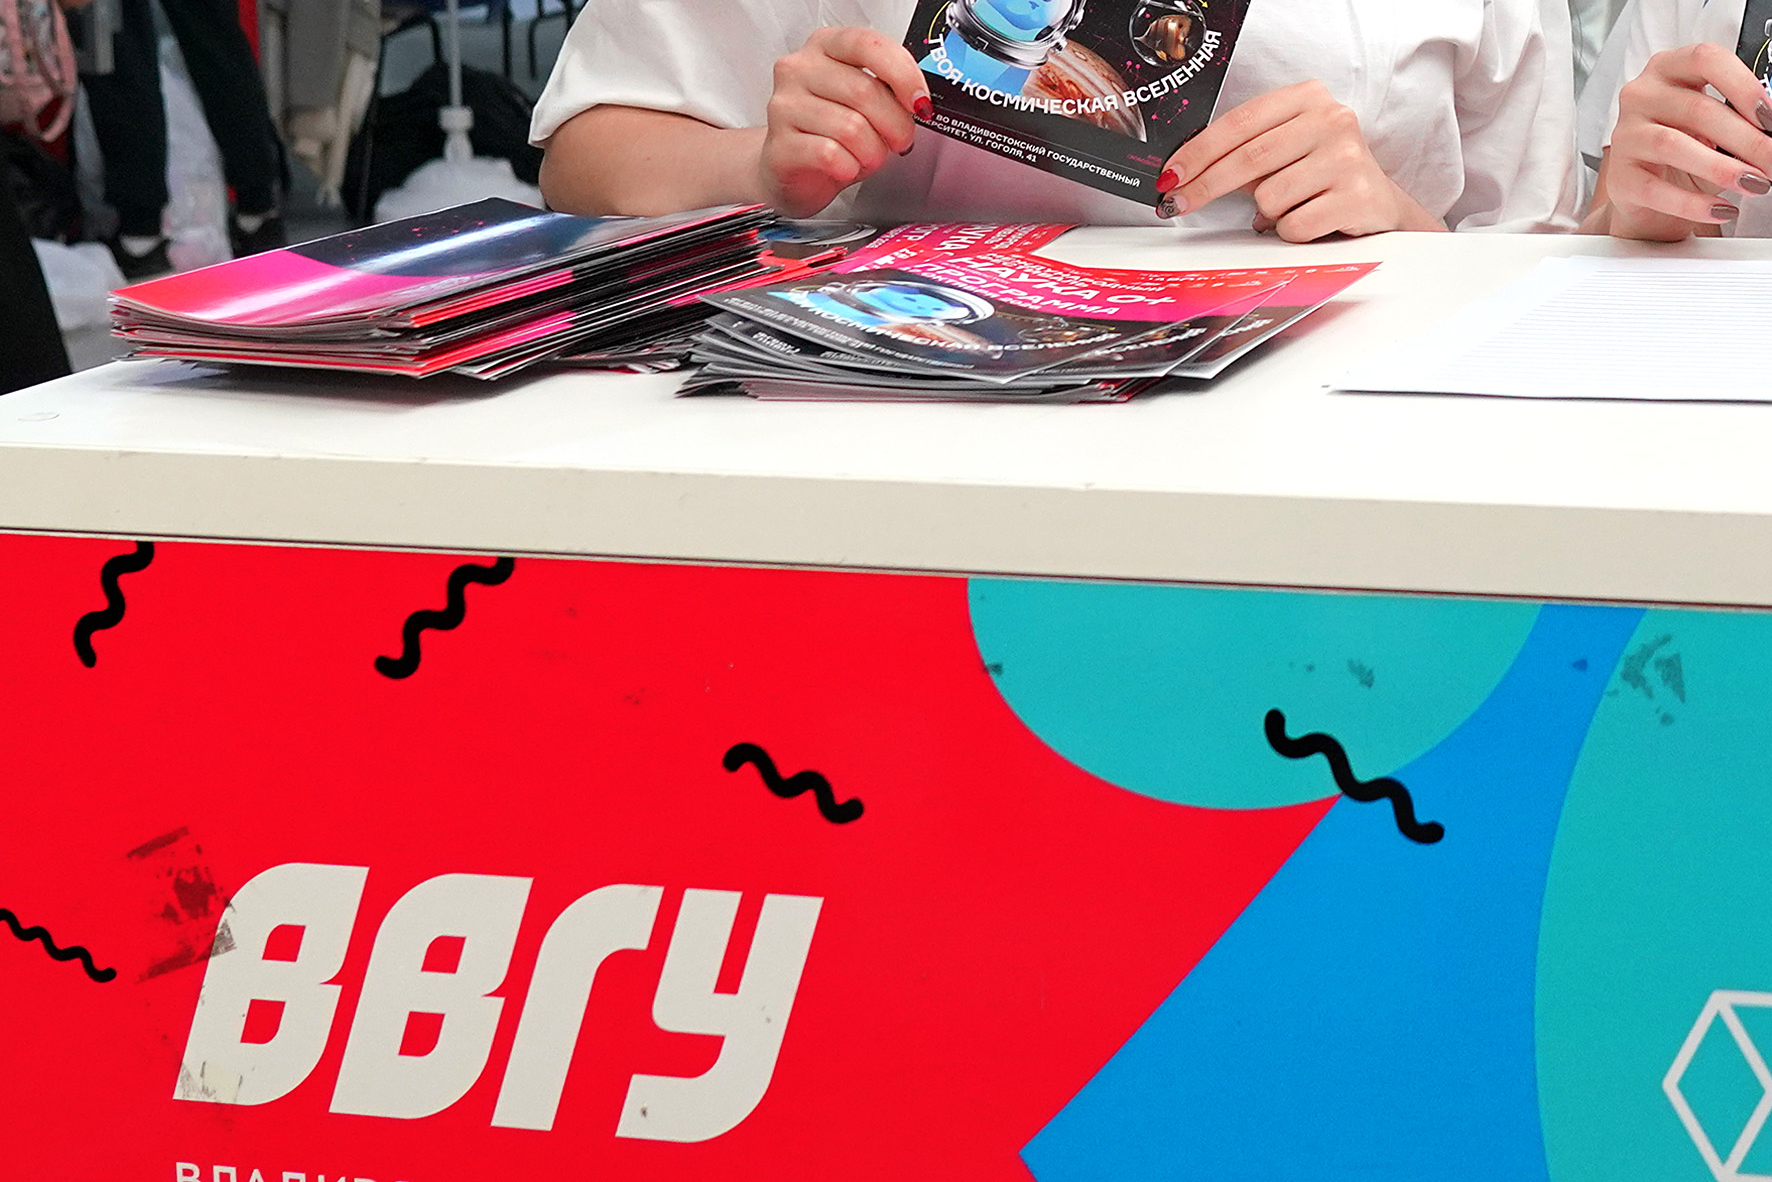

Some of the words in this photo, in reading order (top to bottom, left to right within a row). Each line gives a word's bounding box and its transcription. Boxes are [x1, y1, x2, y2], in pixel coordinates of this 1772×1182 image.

[928, 33, 964, 83] ТВОЯ
[961, 79, 1119, 116] КОСМИЧЕСКАЯ
[1123, 29, 1222, 108] ВСЕЛЕННАЯ
[951, 119, 1046, 156] ВЛАДИВОСТОКСКИЙ
[1046, 150, 1141, 188] ГОСУДАРСТВЕННЫЙ
[985, 139, 1025, 162] ГОГОЛЯ,
[1025, 153, 1037, 163] 41
[914, 263, 1121, 315] ПРОГРАММА
[948, 256, 1100, 300] НАУКА
[173, 862, 824, 1143] ВВГУ
